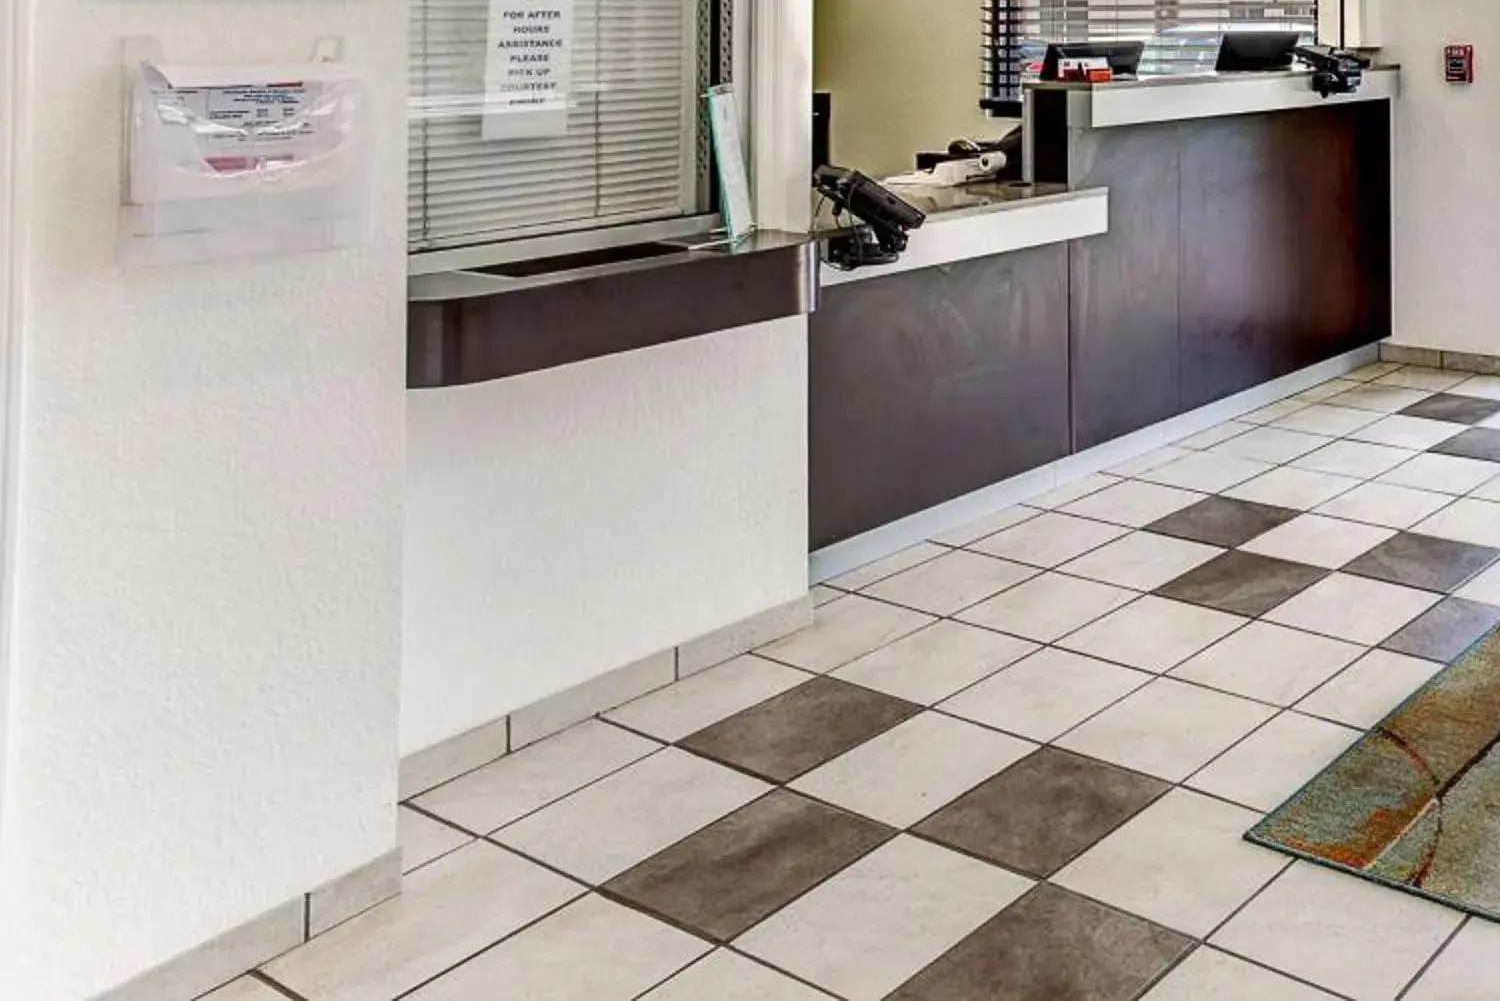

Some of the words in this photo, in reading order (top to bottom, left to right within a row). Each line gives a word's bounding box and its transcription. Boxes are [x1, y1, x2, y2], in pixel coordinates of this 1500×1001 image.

[503, 11, 525, 19] FOR
[528, 10, 561, 19] AFTER
[513, 25, 550, 34] HOURS
[497, 39, 563, 48] ASSISTANCE
[509, 54, 550, 63] PLEASE
[535, 68, 551, 76] UP
